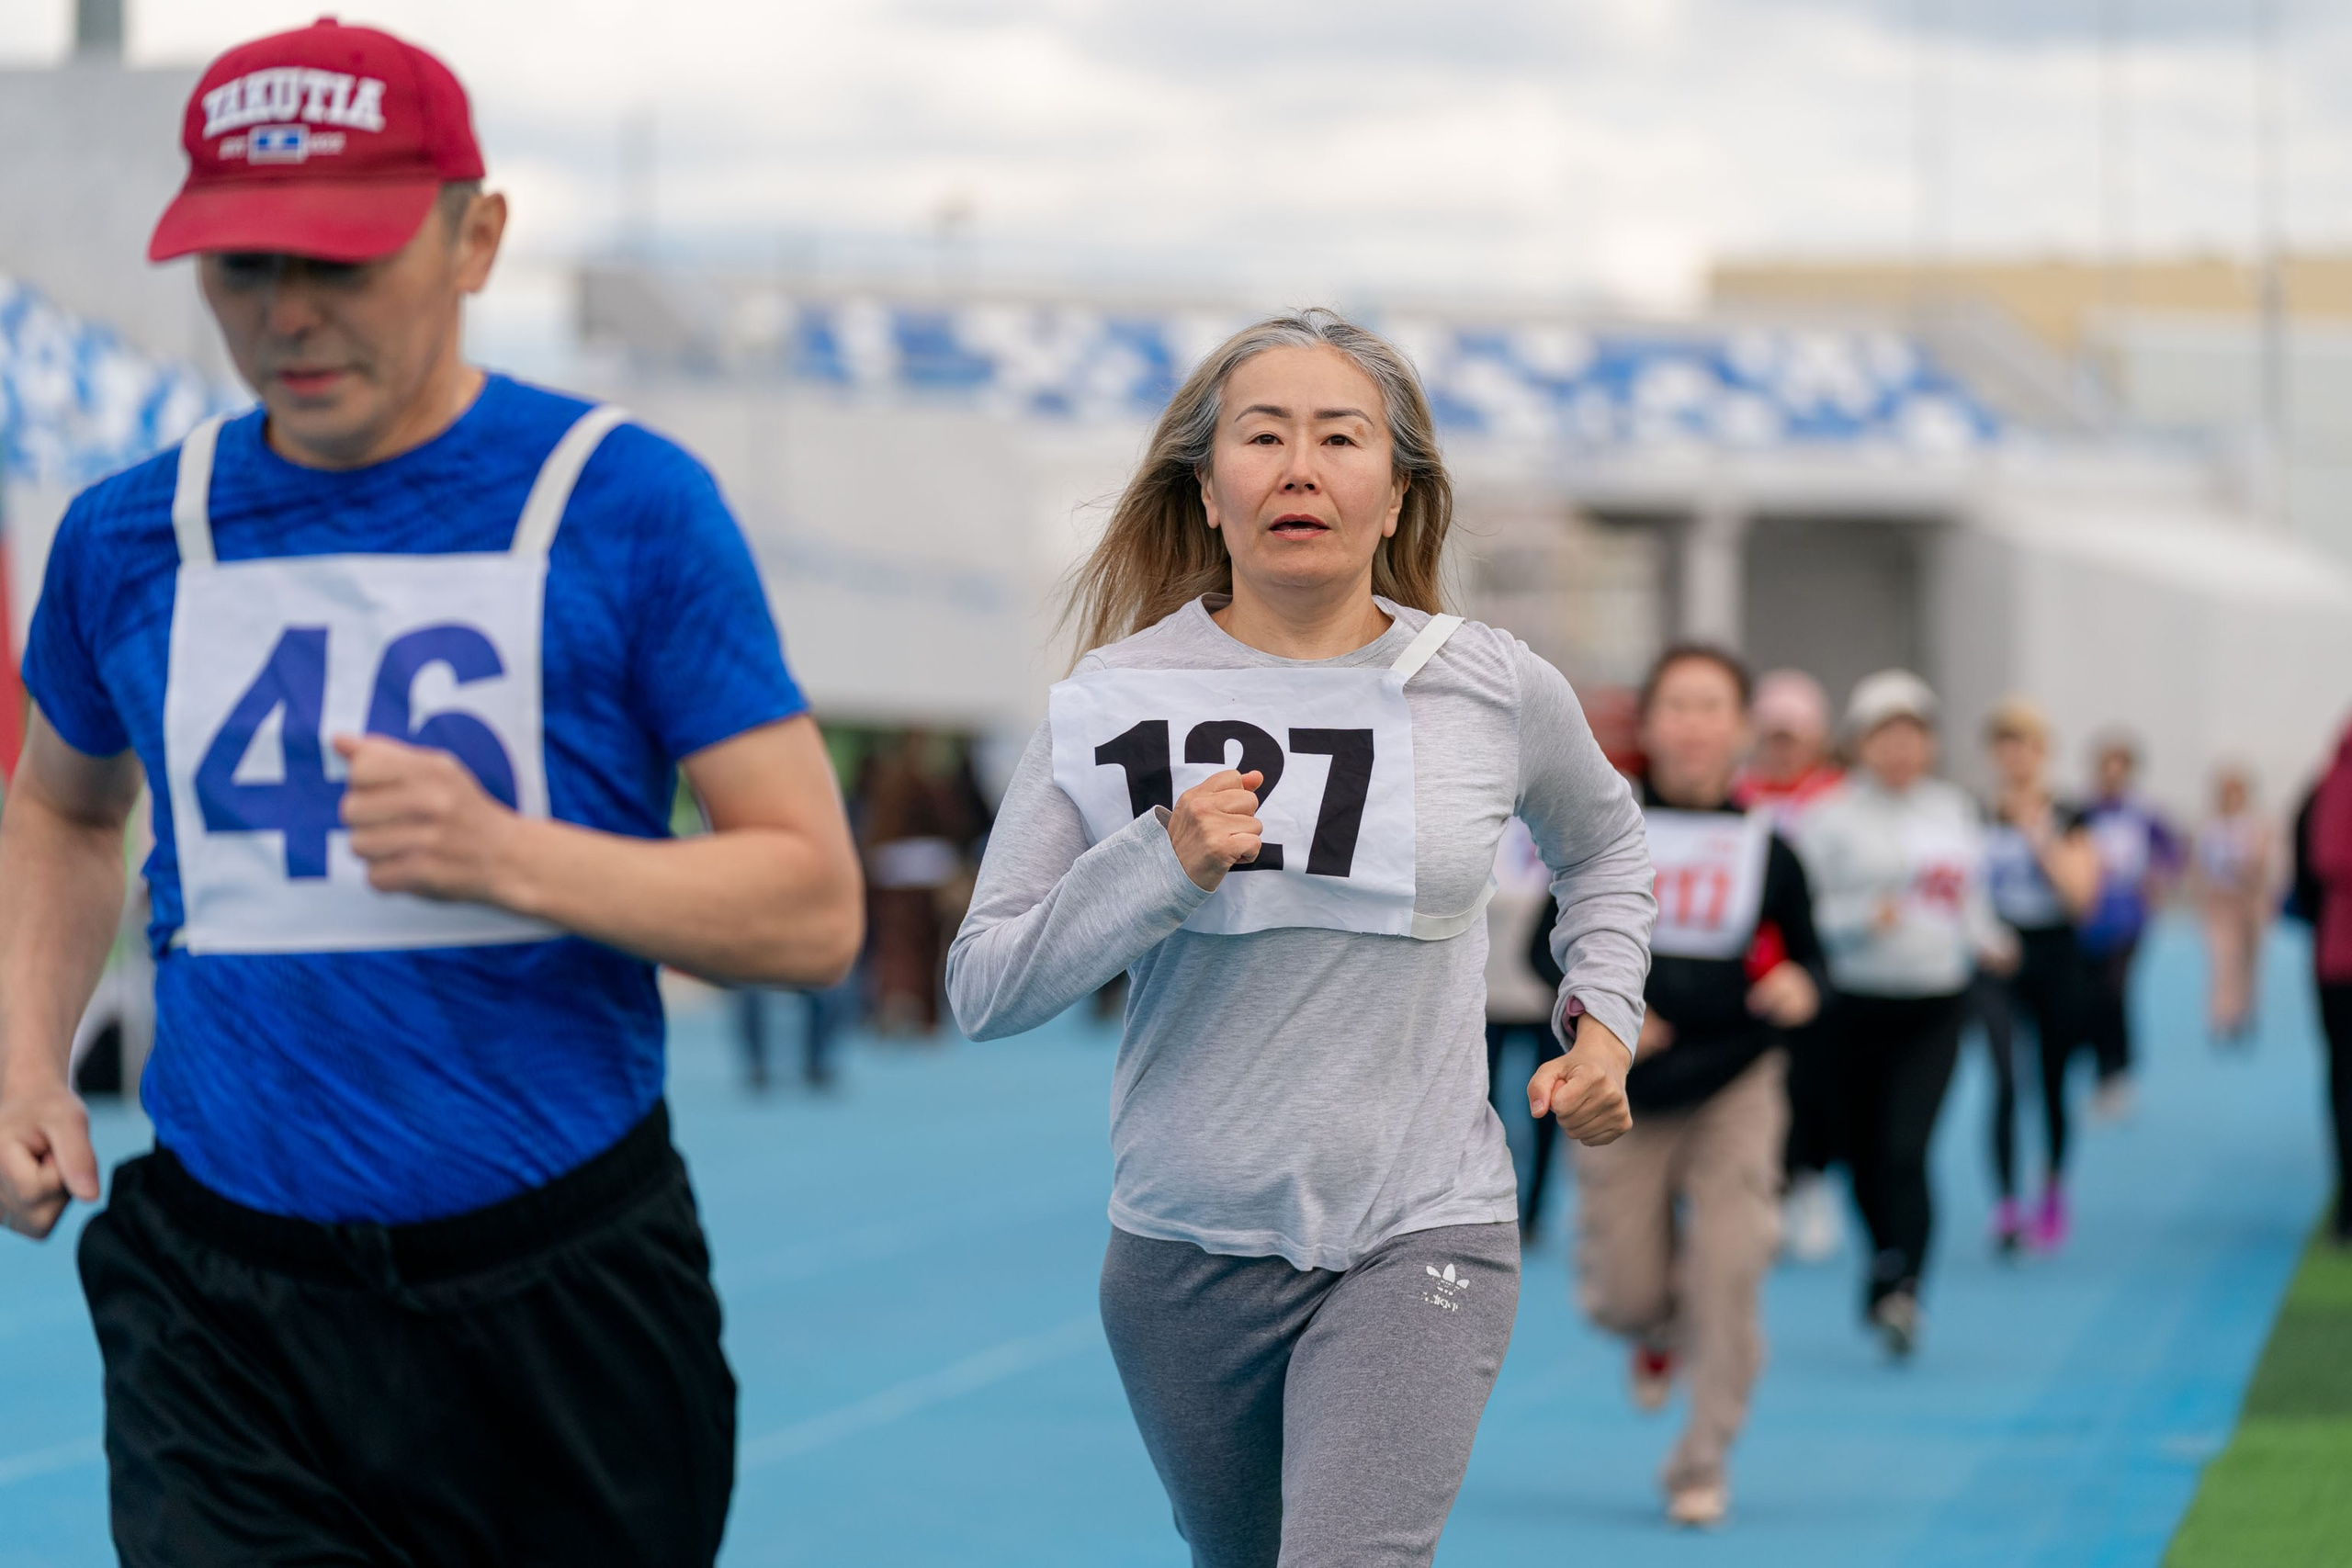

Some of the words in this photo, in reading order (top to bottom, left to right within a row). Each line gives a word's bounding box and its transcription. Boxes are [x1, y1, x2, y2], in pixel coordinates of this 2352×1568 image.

[202, 66, 386, 141] YAKUTIA
[195, 619, 519, 883] 46
[1095, 719, 1374, 878] 127
